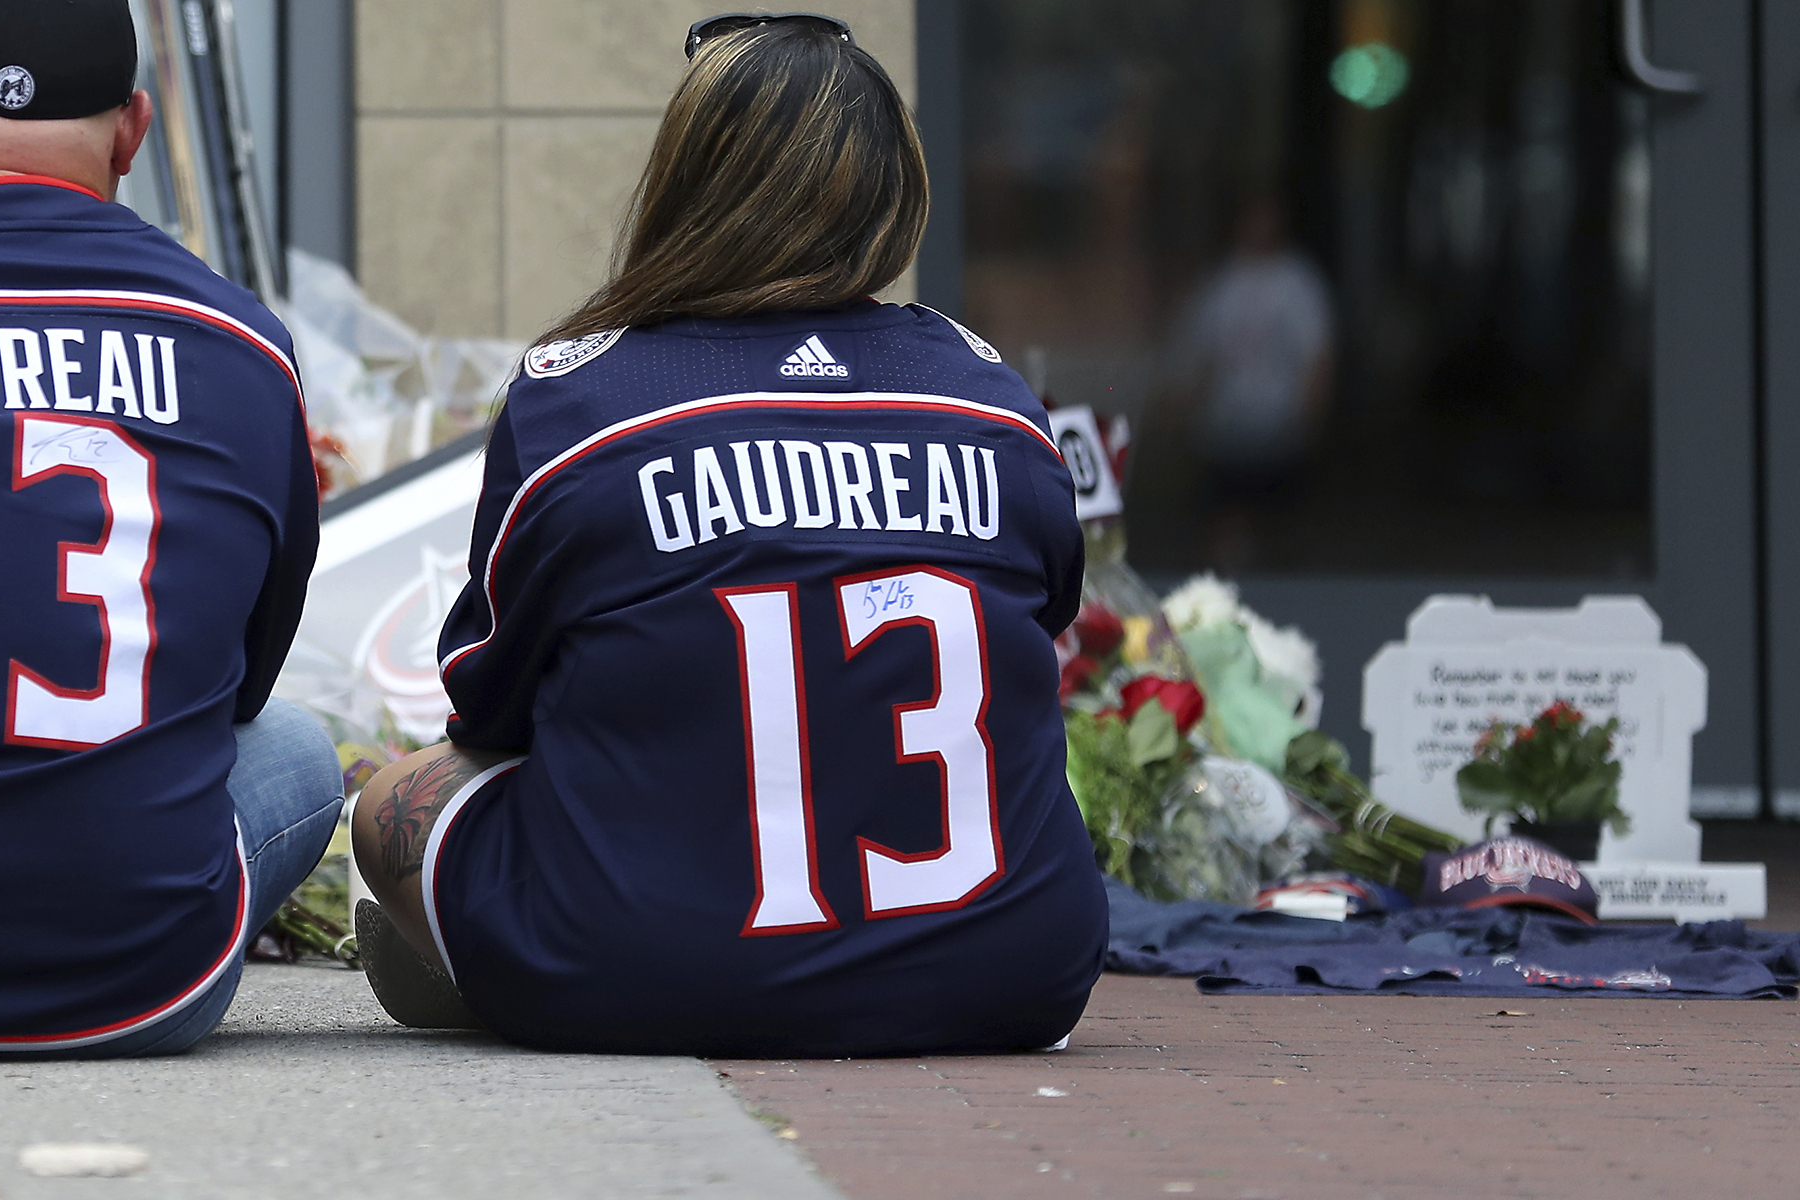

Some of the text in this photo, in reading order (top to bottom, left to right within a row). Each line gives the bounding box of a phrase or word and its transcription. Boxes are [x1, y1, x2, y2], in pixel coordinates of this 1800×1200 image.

[780, 359, 849, 379] adidas
[638, 440, 999, 552] GAUDREAU
[712, 563, 1005, 936] 13
